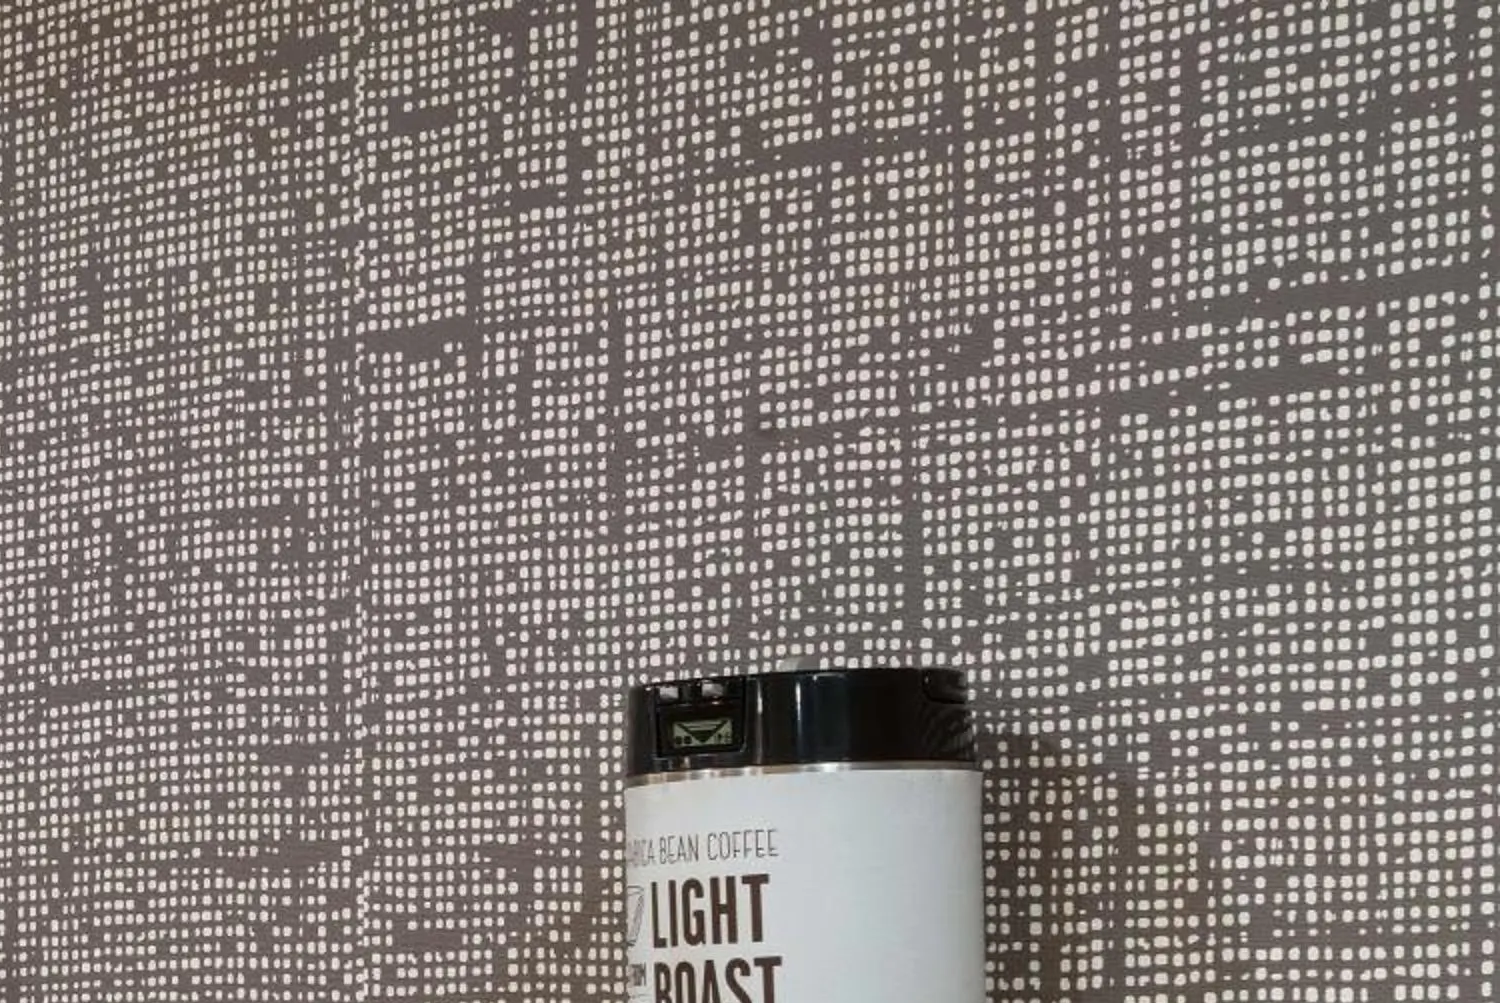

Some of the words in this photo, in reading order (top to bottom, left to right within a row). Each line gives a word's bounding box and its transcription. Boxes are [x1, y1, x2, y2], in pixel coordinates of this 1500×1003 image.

[659, 834, 699, 865] BEAN
[708, 829, 779, 860] COFFEE
[651, 873, 770, 949] LIGHT
